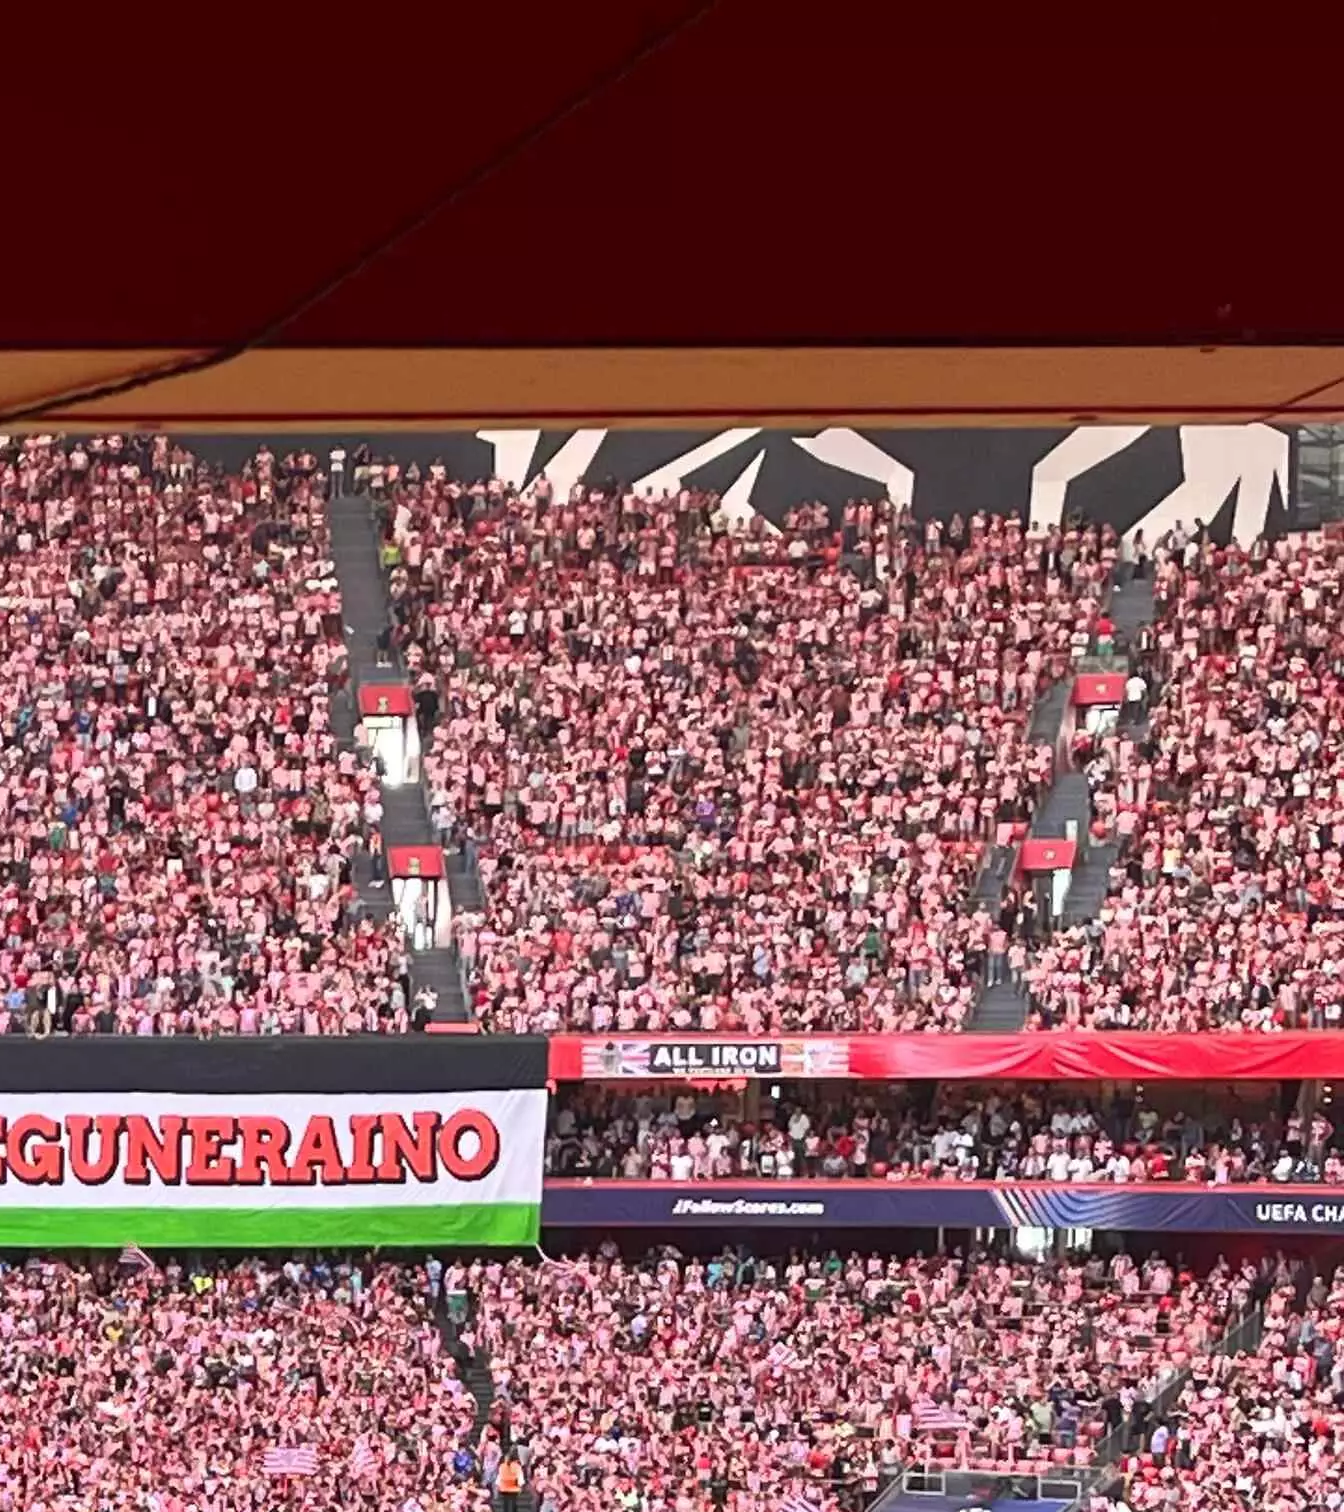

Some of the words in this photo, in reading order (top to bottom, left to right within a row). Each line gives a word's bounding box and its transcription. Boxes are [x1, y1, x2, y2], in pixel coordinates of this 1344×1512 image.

[653, 1046, 703, 1067] ALL
[712, 1046, 777, 1067] IRON
[1256, 1203, 1307, 1222] UEFA
